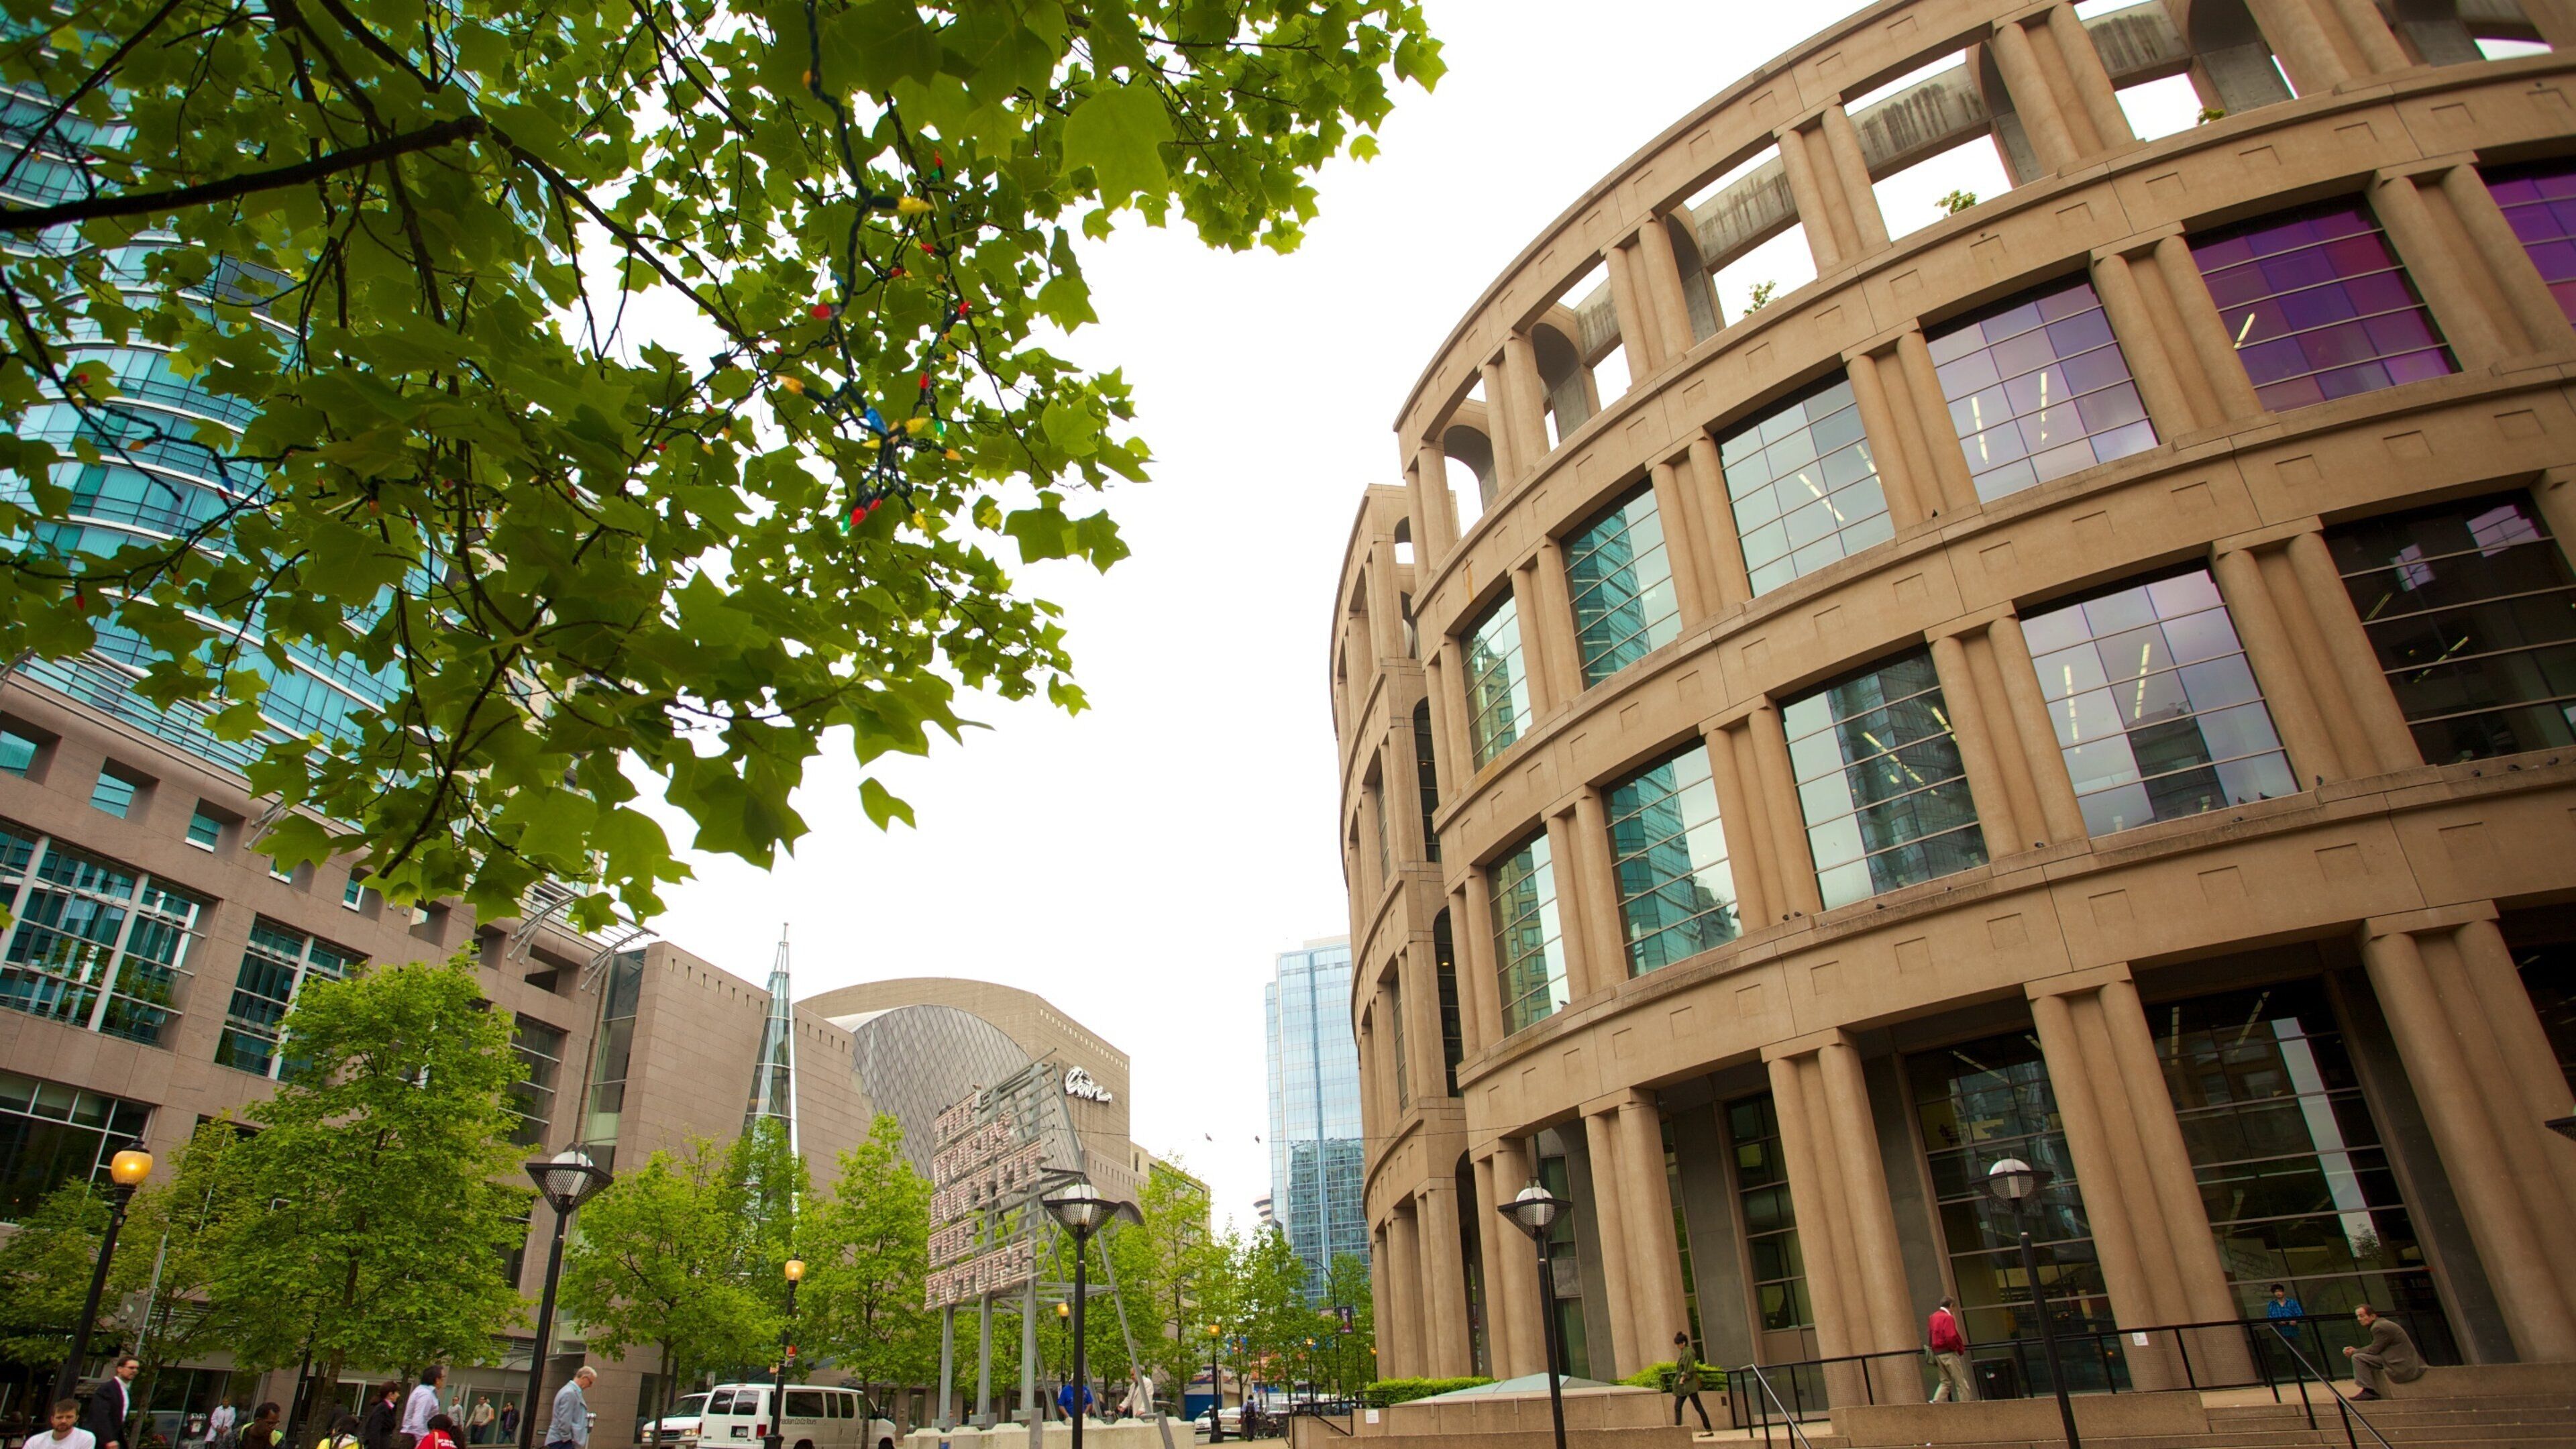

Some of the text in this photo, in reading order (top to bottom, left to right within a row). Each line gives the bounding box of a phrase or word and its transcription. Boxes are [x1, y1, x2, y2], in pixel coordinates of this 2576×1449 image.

[1065, 1065, 1113, 1103] Centre
[933, 1111, 1013, 1188] WORDS
[935, 1091, 979, 1151] THE
[997, 1138, 1042, 1197] FIT
[928, 1218, 973, 1269] THE
[924, 1238, 1030, 1311] PICTURE
